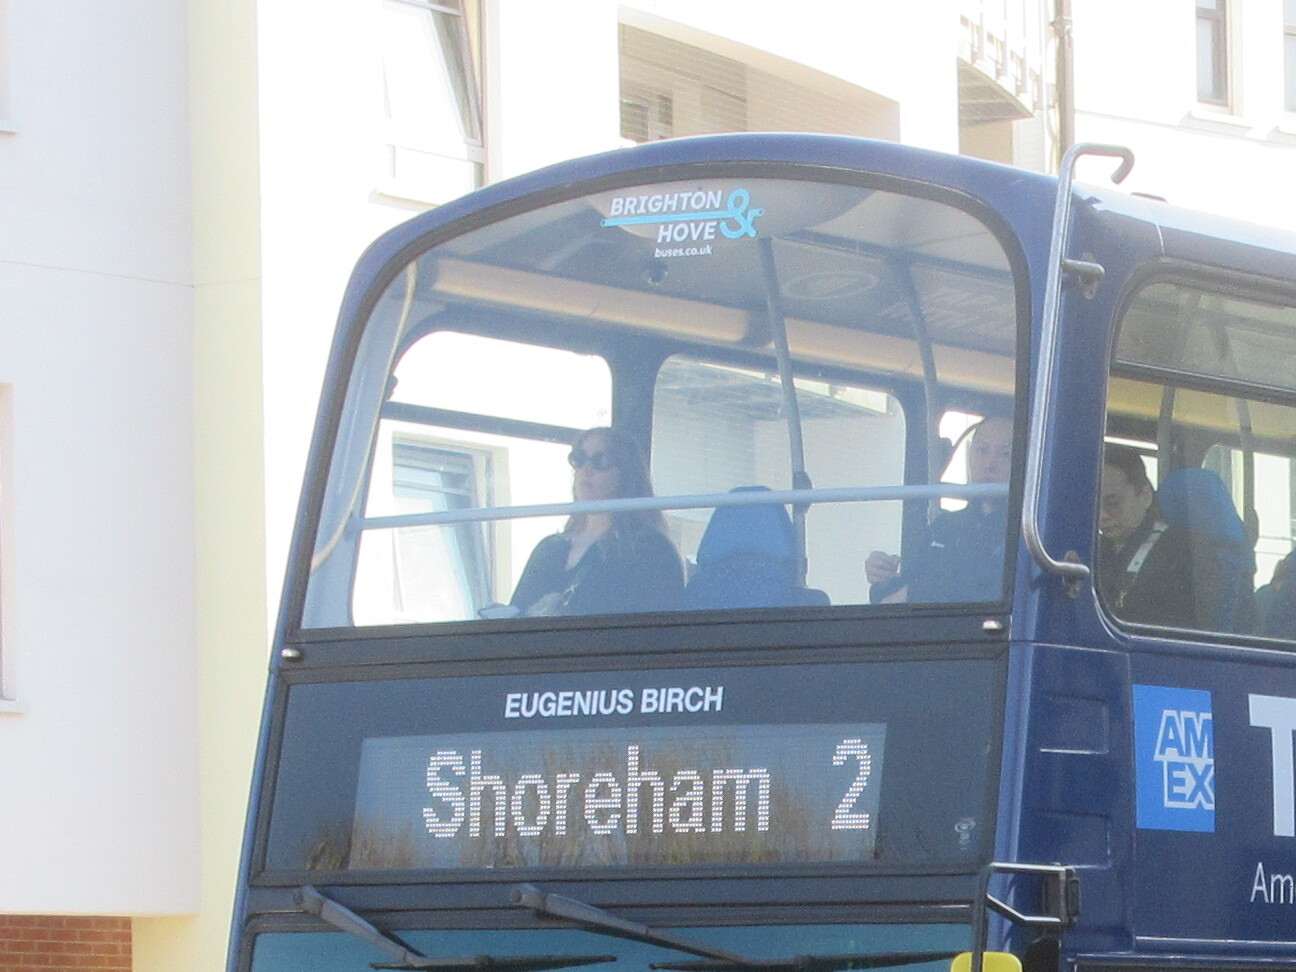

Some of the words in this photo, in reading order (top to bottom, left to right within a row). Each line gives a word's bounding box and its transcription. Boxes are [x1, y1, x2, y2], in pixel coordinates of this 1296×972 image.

[610, 190, 722, 216] BRIGHTON
[657, 221, 717, 243] HOVE
[655, 245, 712, 258] buses.co.uk
[505, 689, 633, 719] EUGENIUS
[641, 687, 723, 713] BIRCH
[1155, 710, 1213, 761] AM
[423, 746, 771, 841] Shoreham
[830, 737, 873, 833] 2
[1163, 761, 1215, 809] EX
